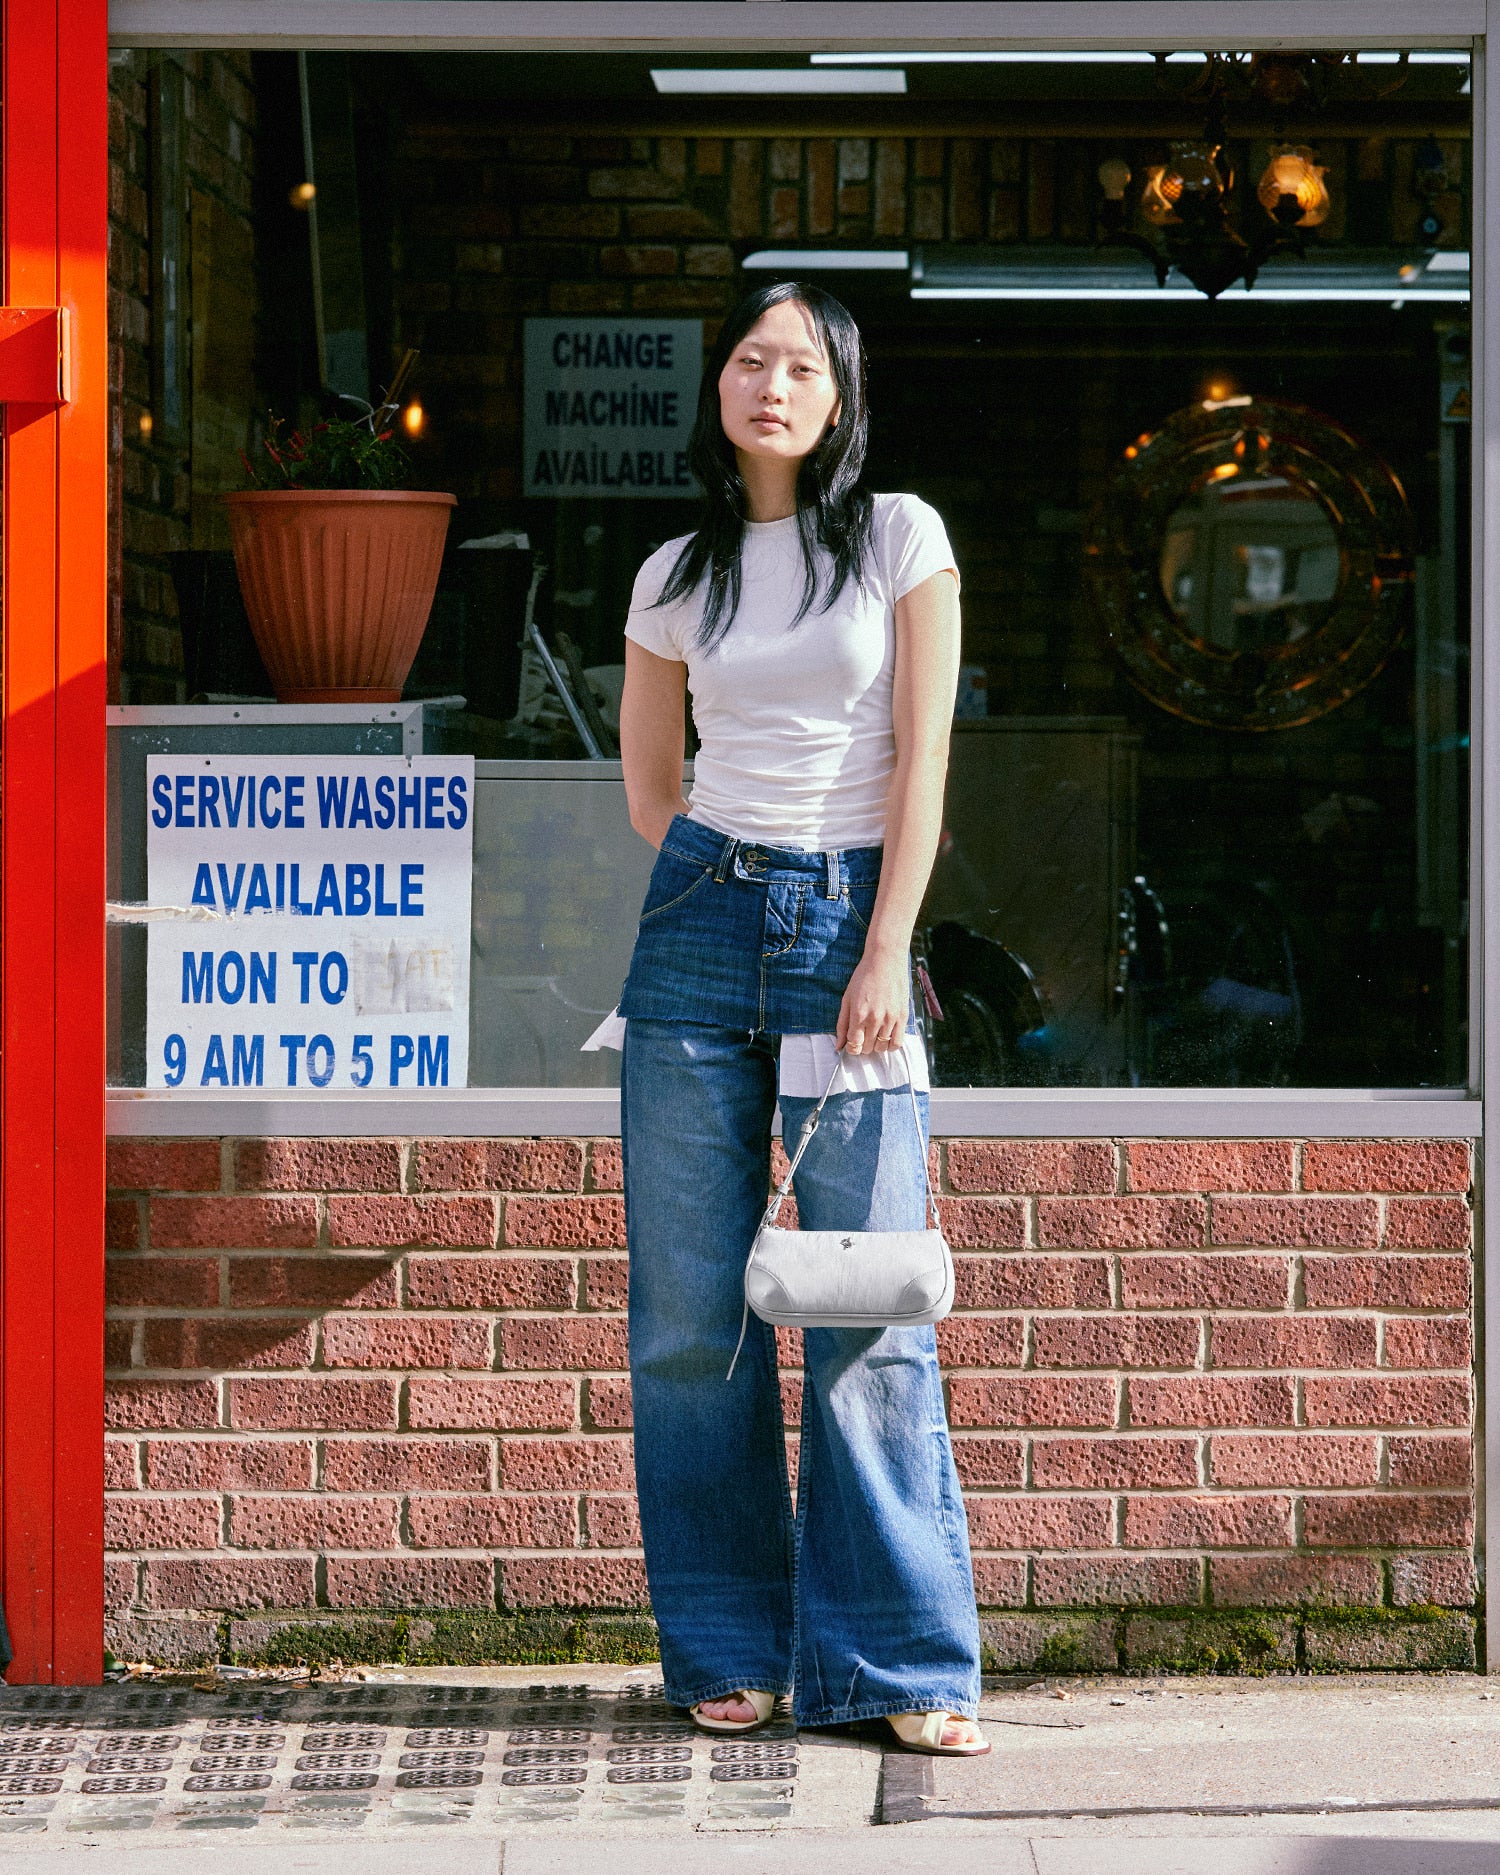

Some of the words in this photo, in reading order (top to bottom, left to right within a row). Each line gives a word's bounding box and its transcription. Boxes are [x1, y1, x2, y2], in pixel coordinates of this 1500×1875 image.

[553, 333, 673, 368] CHANGE
[152, 775, 305, 828] SERVICE
[317, 775, 468, 830] WASHES
[191, 863, 424, 916] AVAILABLE
[181, 951, 277, 1003] MON
[292, 951, 348, 1004] TO
[163, 1033, 186, 1087] 9
[200, 1034, 264, 1087] AM
[280, 1034, 336, 1087] TO
[350, 1034, 373, 1087] 5
[390, 1034, 449, 1087] PM
